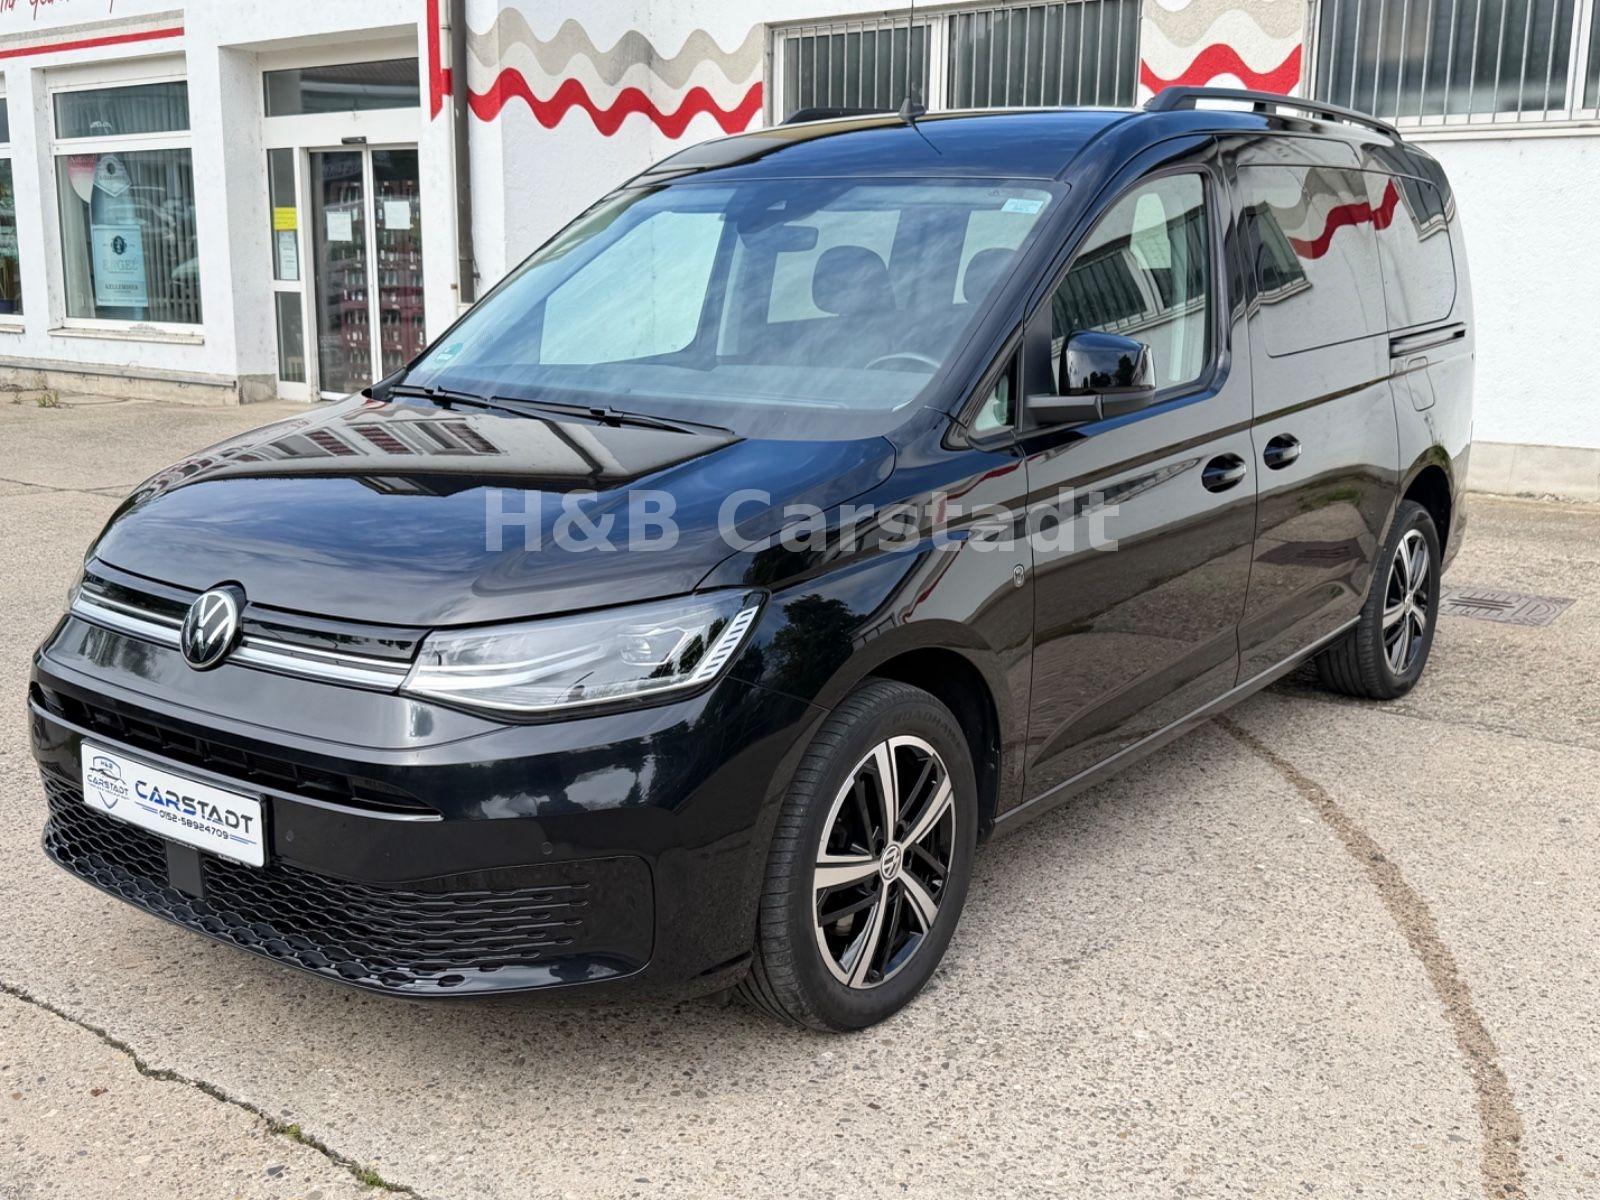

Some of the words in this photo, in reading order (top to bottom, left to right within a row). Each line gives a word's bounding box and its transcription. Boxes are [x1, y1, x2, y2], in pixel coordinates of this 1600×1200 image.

[87, 774, 128, 796] CARSTADT
[135, 780, 254, 834] CARSTADT
[158, 809, 230, 840] 0152-58924709
